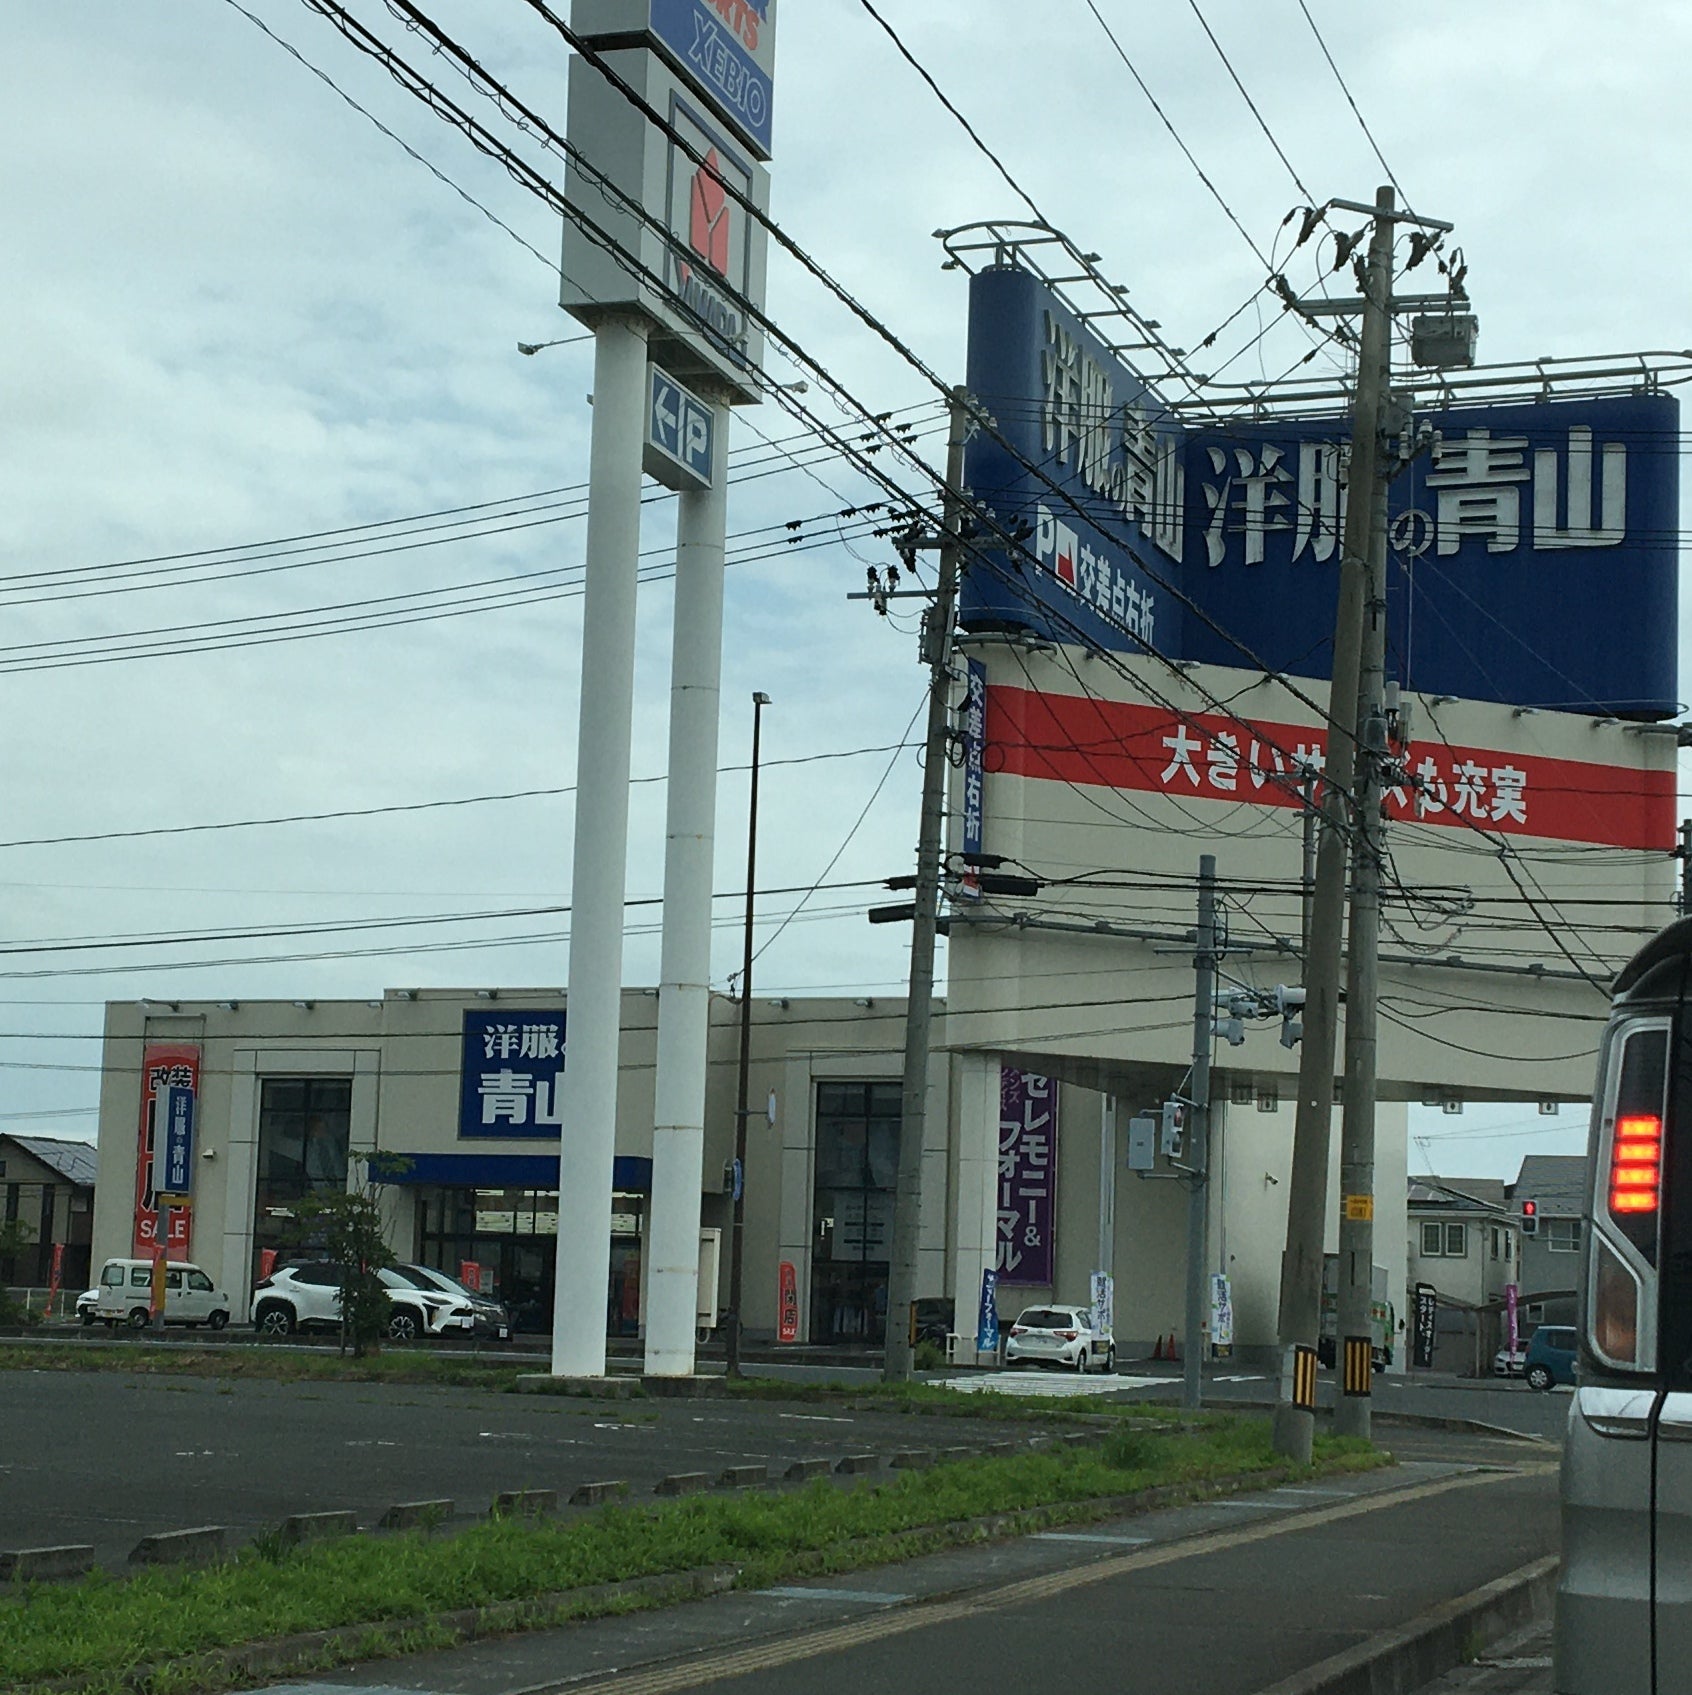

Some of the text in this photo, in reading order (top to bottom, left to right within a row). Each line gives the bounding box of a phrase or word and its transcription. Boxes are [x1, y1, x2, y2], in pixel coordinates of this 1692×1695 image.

[688, 9, 766, 128] XEBIO
[686, 407, 708, 464] P
[1041, 309, 1184, 563] 洋服の青山
[1080, 543, 1154, 655] 交差点右折
[483, 1024, 568, 1059] 洋服
[172, 1096, 187, 1184] 洋服の青山
[1019, 1072, 1050, 1246] セレモニー&
